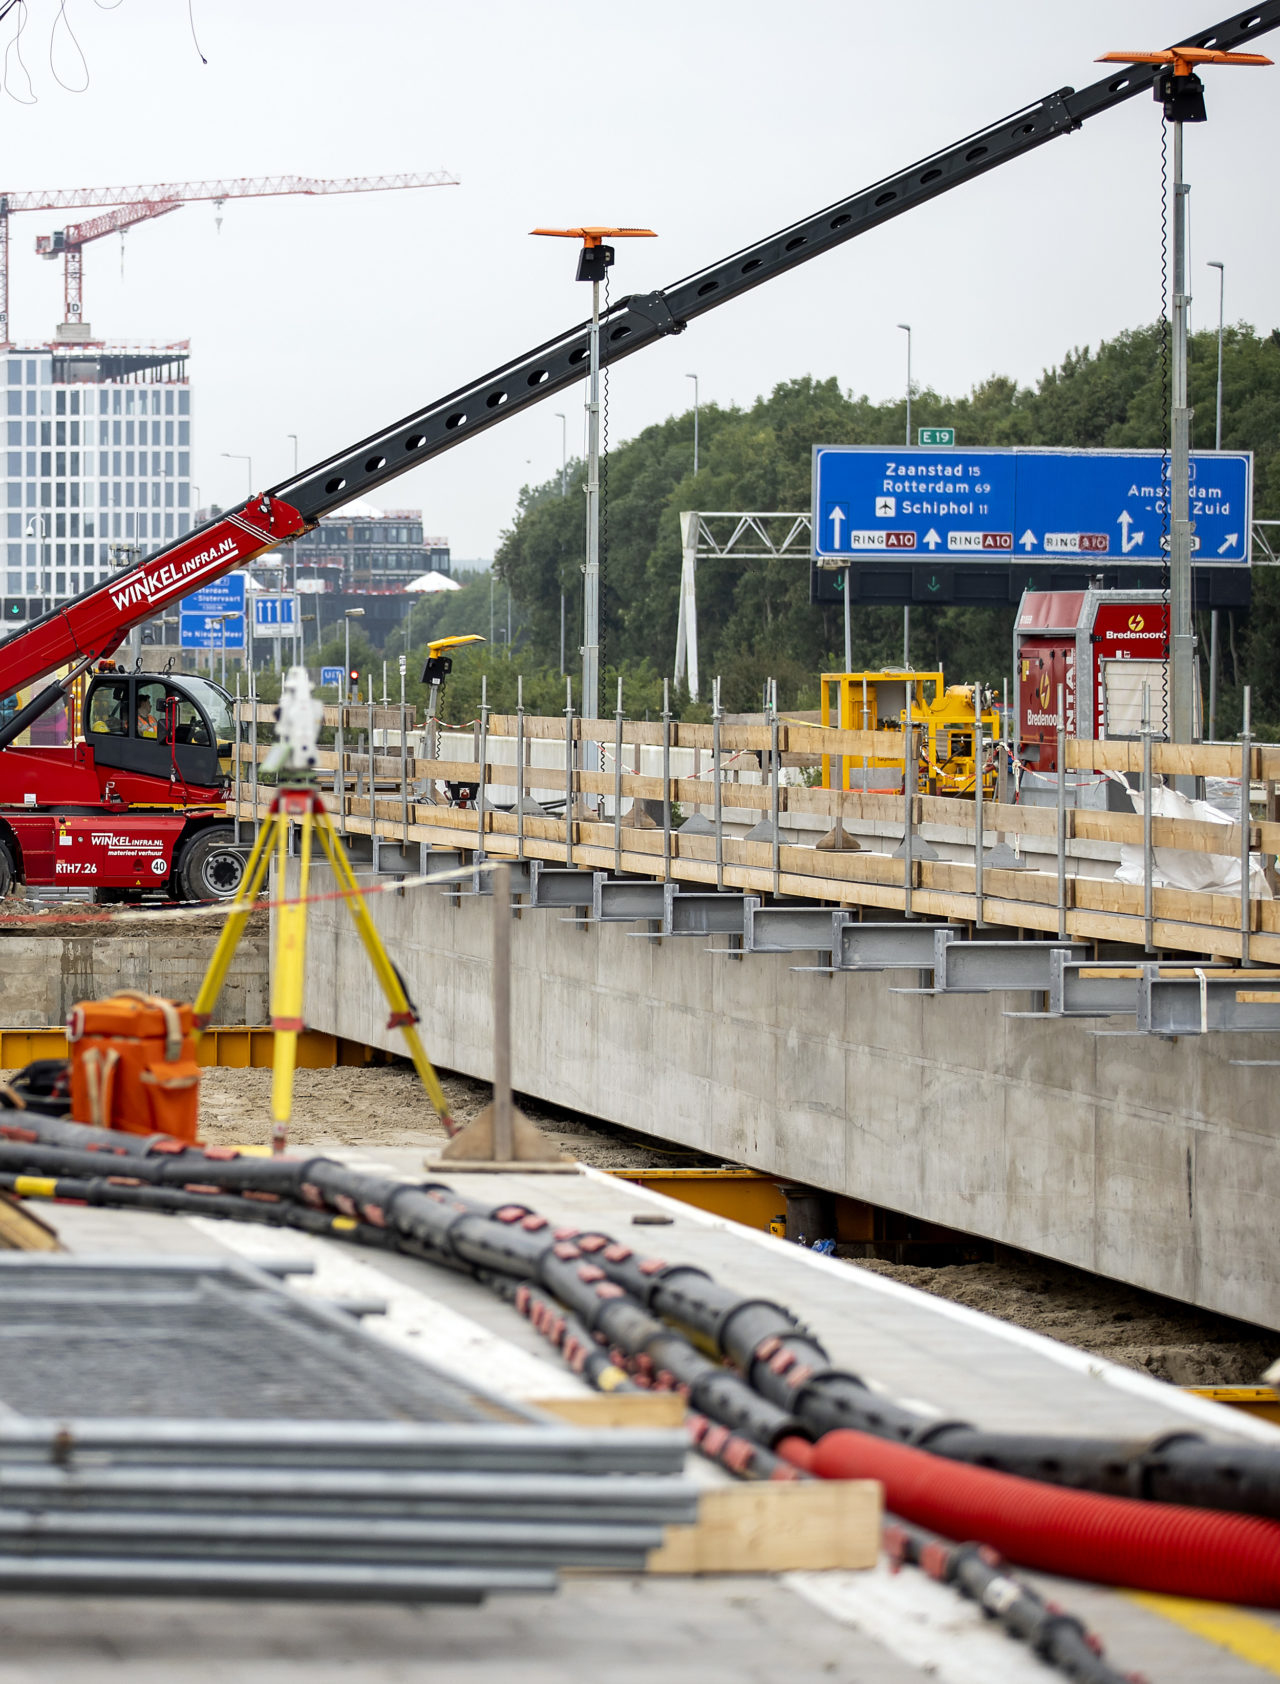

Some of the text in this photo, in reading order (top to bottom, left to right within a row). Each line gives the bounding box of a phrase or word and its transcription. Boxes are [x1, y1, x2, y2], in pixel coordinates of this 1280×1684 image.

[923, 432, 950, 443] E 19
[885, 462, 981, 477] Zaanstad 15
[883, 479, 991, 494] Rotterdam 69
[1128, 484, 1222, 498] Amstdam
[902, 501, 988, 516] Schiphol 11
[1193, 501, 1230, 515] Zuid
[853, 533, 914, 546] RING A10
[950, 534, 1010, 547] RING A10
[1046, 537, 1106, 548] RING A10
[1106, 630, 1167, 639] Bredenoord
[55, 863, 97, 874] RTH7.26
[153, 861, 165, 872] 40
